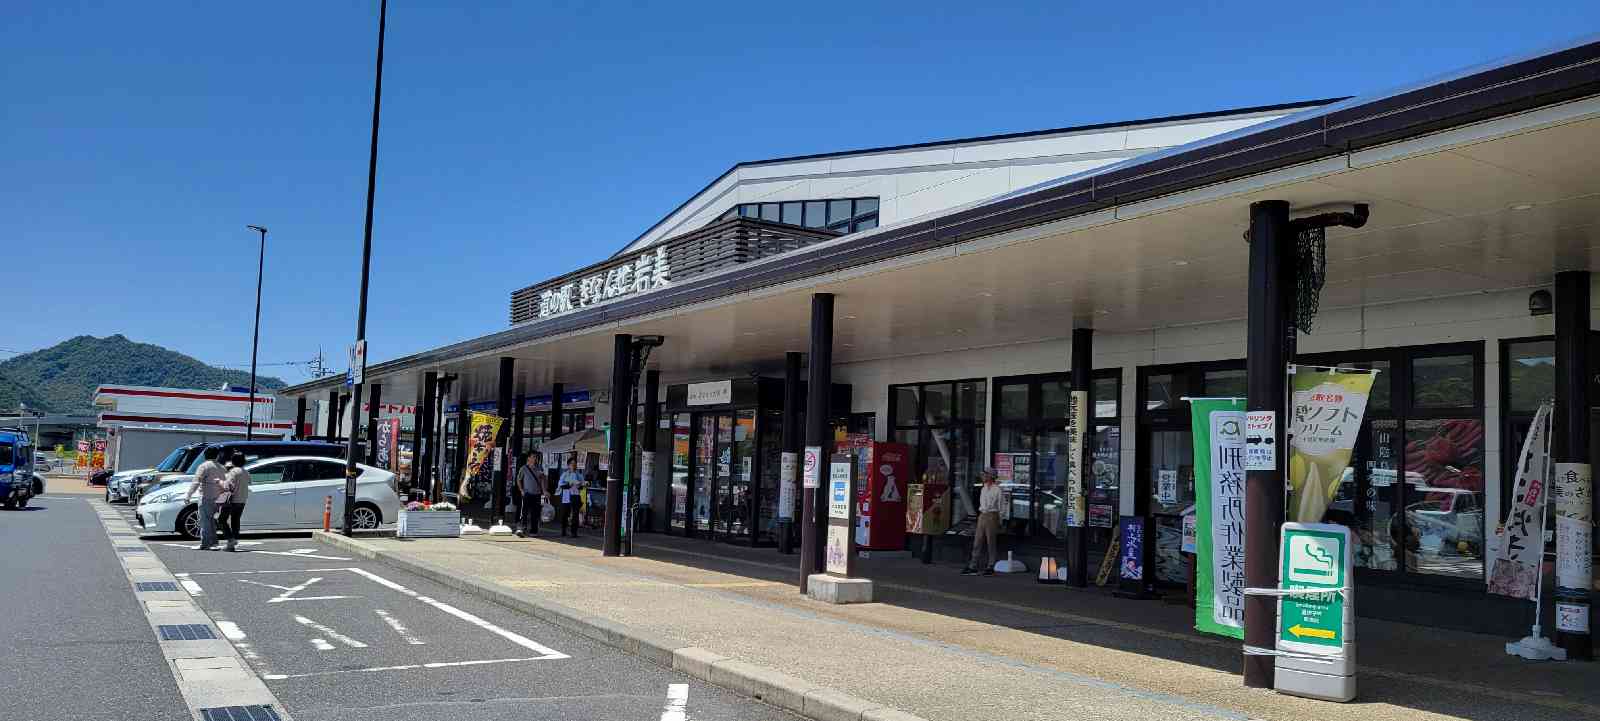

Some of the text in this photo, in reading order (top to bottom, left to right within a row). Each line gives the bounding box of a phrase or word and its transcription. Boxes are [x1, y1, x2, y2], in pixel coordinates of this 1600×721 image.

[539, 283, 573, 318] 道の駅
[1306, 406, 1359, 423] ソフト
[1302, 423, 1343, 437] クリーム
